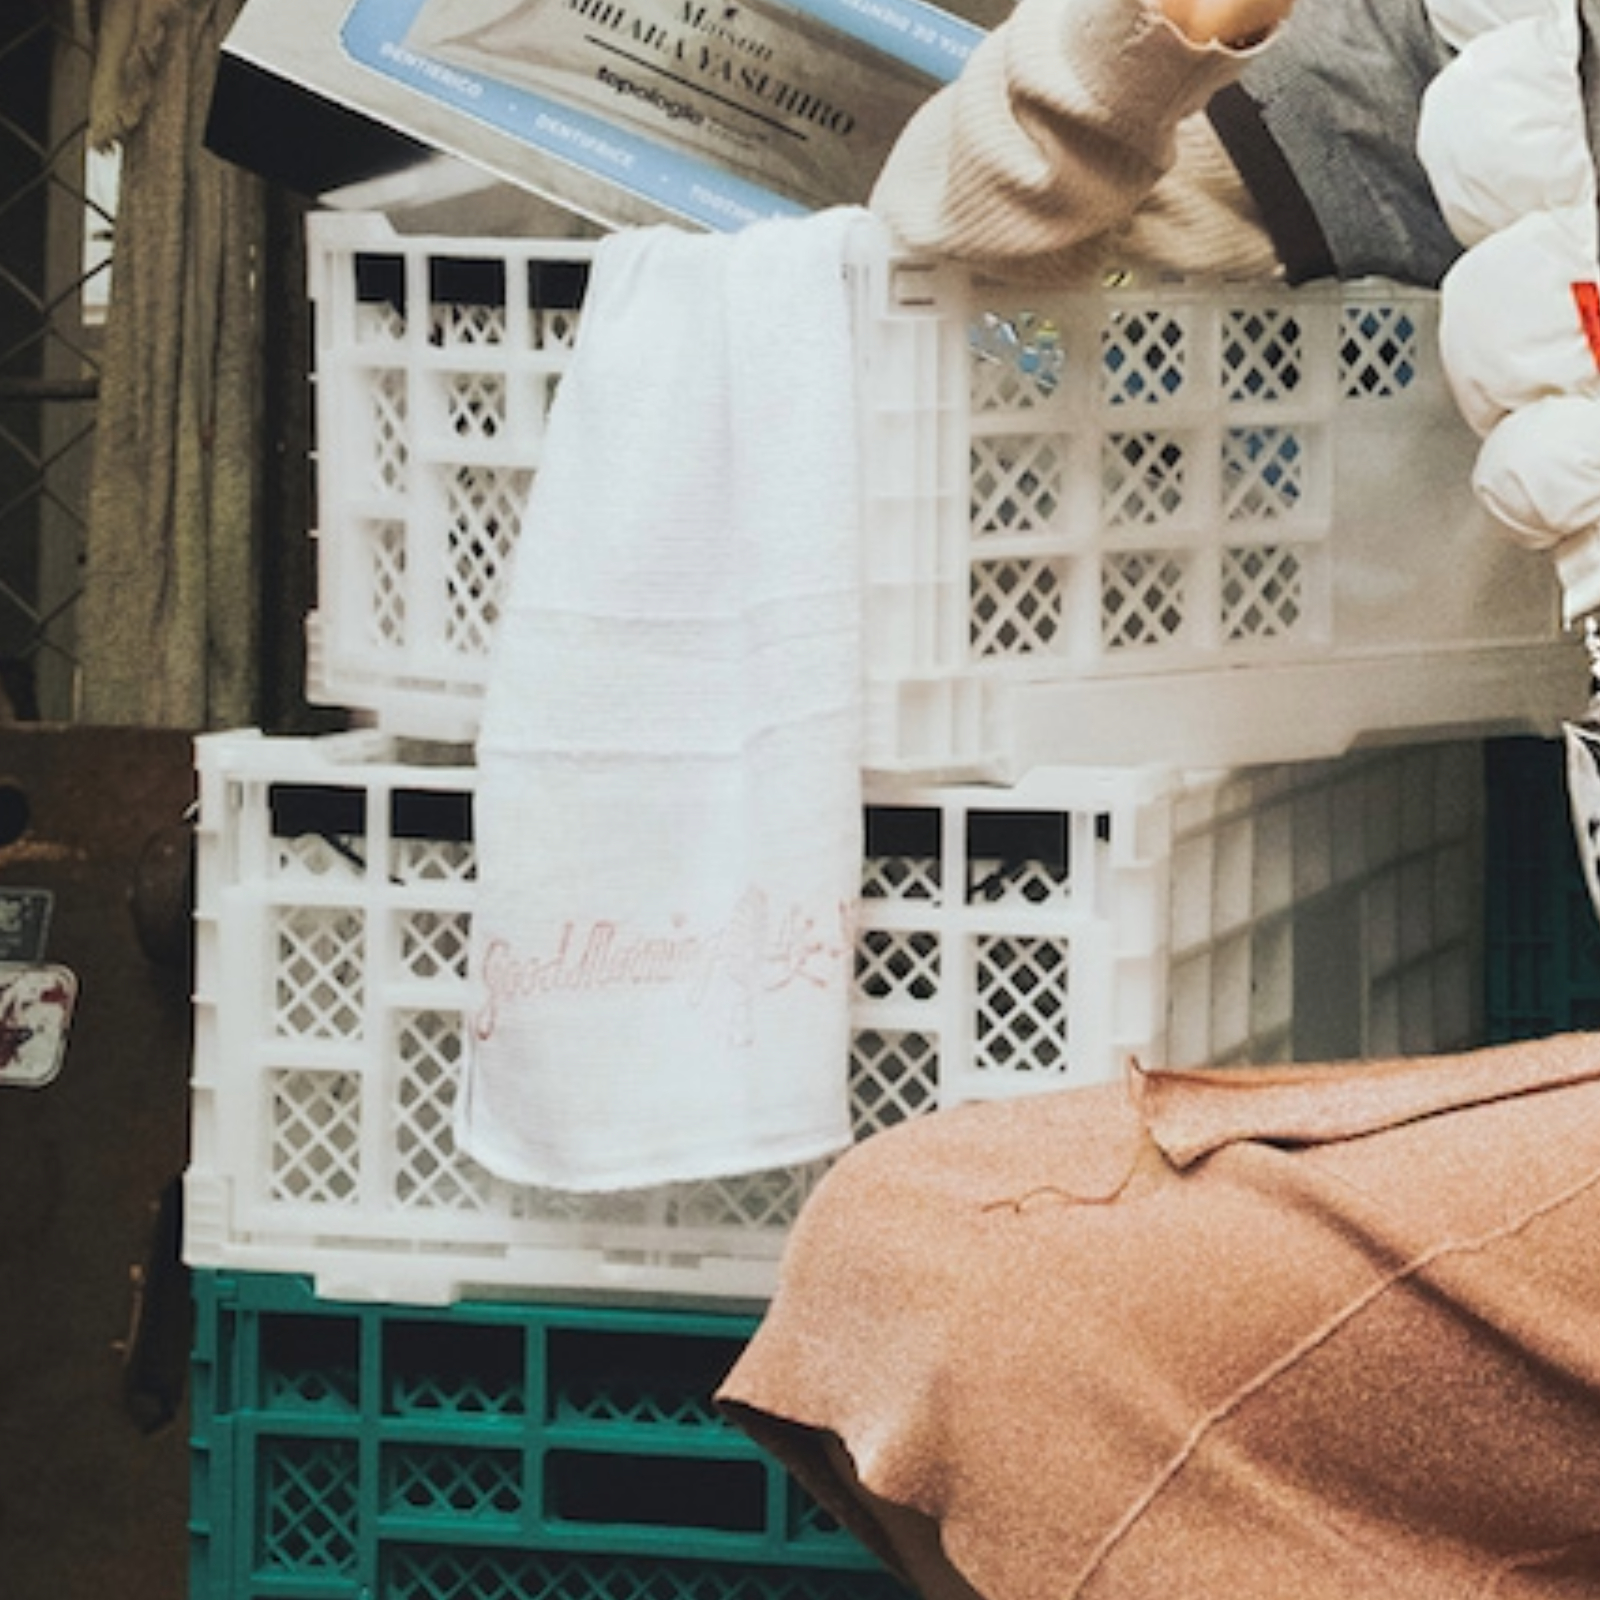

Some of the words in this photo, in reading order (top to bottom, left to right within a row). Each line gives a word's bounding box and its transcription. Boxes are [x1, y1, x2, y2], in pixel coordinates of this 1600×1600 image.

[676, 0, 774, 62] Maison
[596, 65, 705, 127] topologie
[698, 45, 856, 137] YASUHIRO
